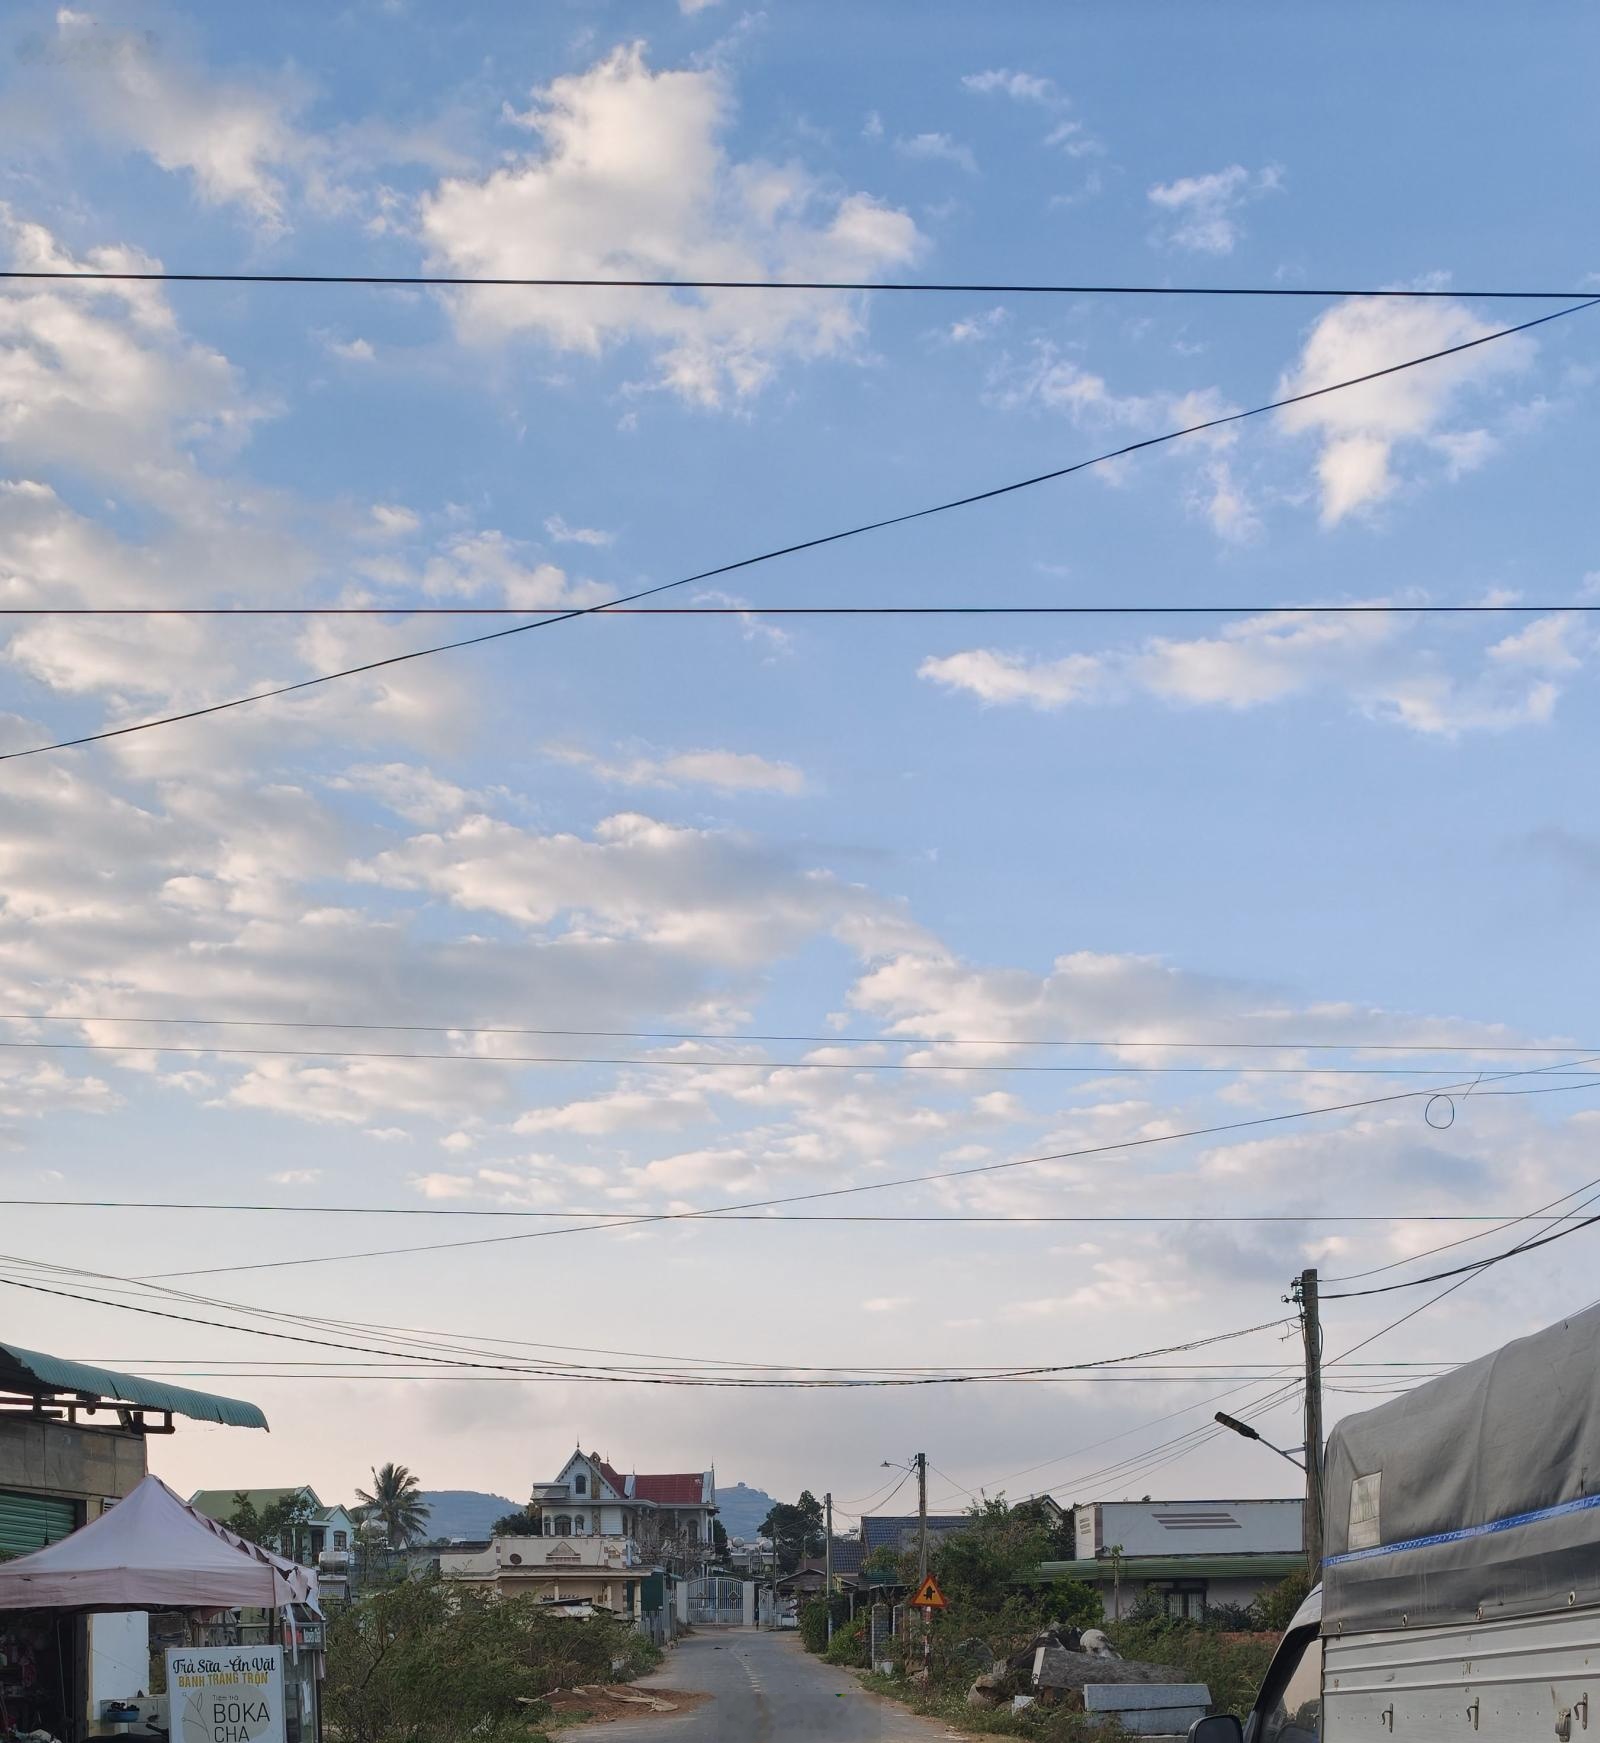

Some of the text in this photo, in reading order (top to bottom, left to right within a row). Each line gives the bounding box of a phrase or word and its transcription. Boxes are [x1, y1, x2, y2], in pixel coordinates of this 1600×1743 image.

[172, 1659, 196, 1674] Trà
[197, 1659, 221, 1673] Sữa
[252, 1657, 276, 1674] Vặt
[213, 1702, 270, 1724] BOKA
[214, 1725, 250, 1743] CHA
